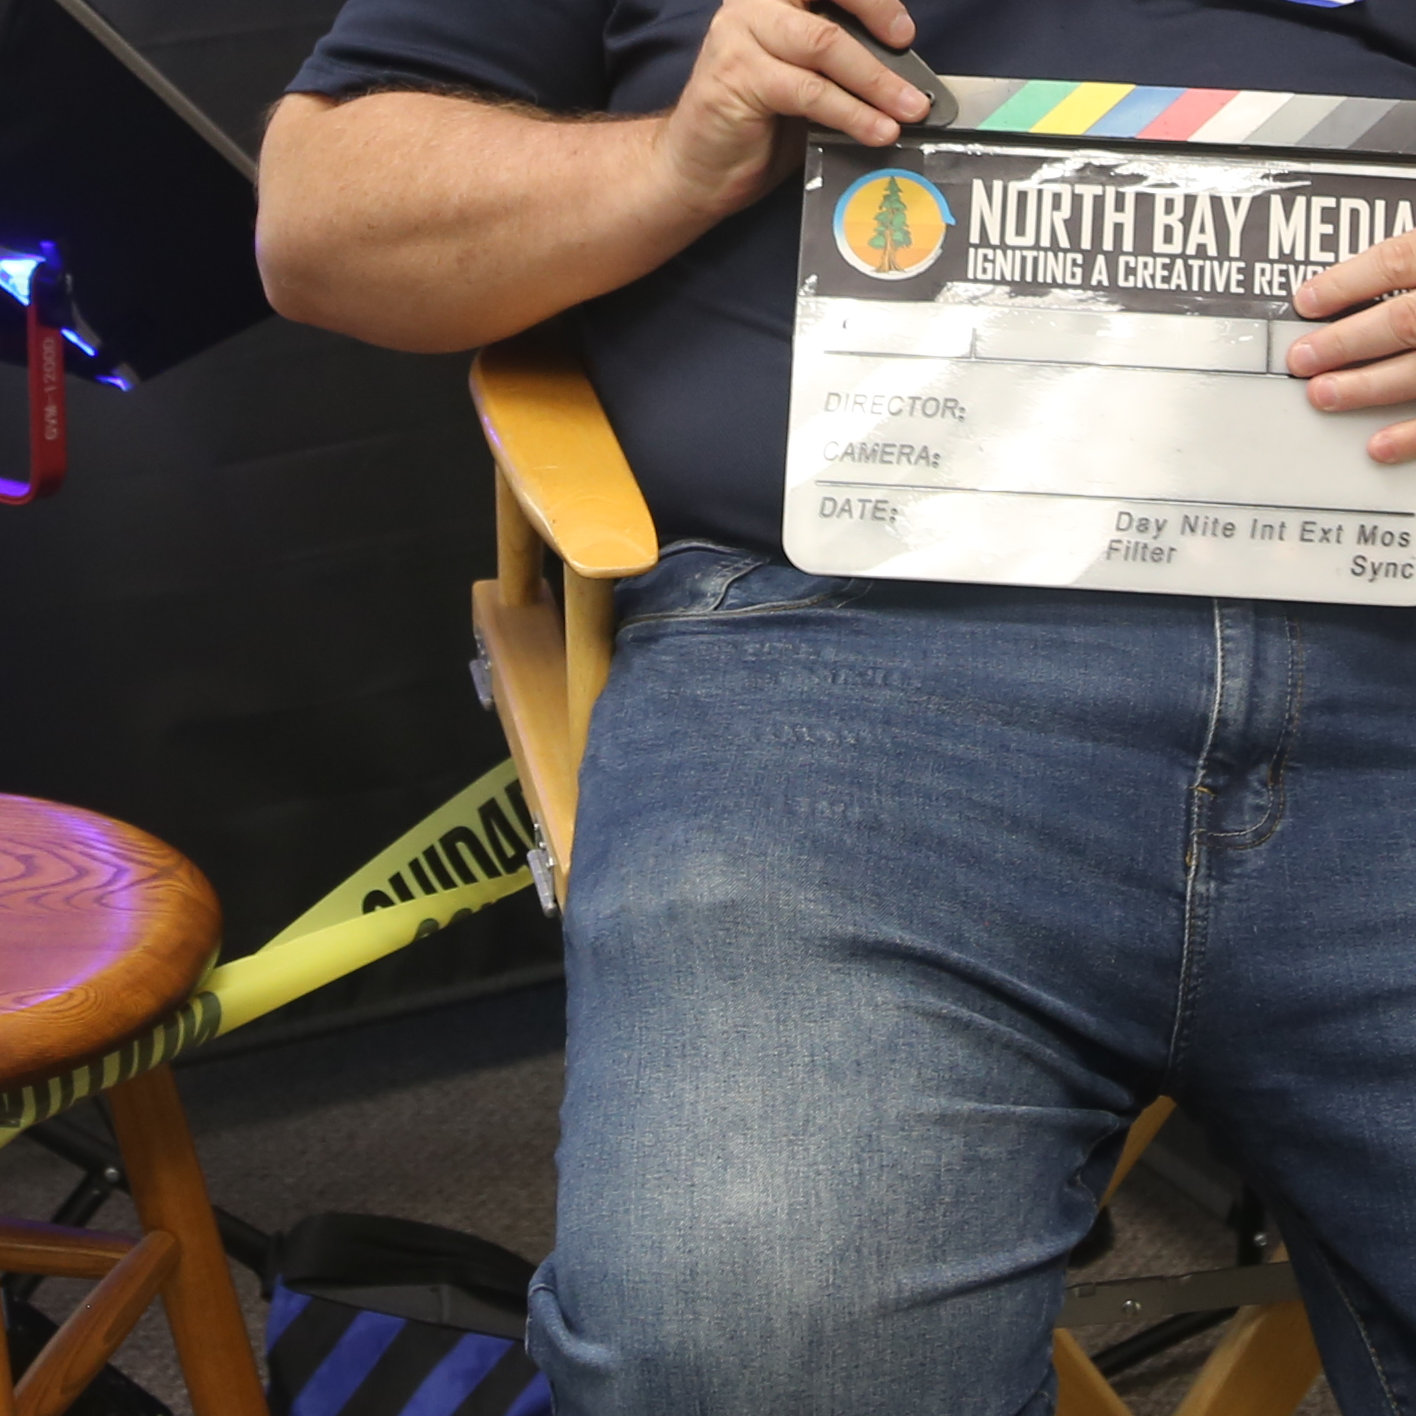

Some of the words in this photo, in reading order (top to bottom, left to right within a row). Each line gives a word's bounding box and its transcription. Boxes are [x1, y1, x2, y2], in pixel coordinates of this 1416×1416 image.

[968, 178, 1134, 252] NORTH
[1153, 190, 1254, 258] BAY
[966, 247, 1084, 285] IGNITING
[1090, 253, 1110, 287] A
[1117, 255, 1246, 294] CREATIVE
[823, 391, 967, 422] DIRECTOR:
[823, 441, 942, 469] CAMERA:
[819, 495, 899, 523] DATE:
[1115, 510, 1168, 541] Day
[1180, 513, 1236, 539] Nite
[1249, 517, 1287, 542] Int
[1299, 520, 1344, 545] Ext
[1356, 524, 1412, 548] Mos
[1105, 538, 1177, 564] Filter
[1350, 554, 1415, 583] Sync
